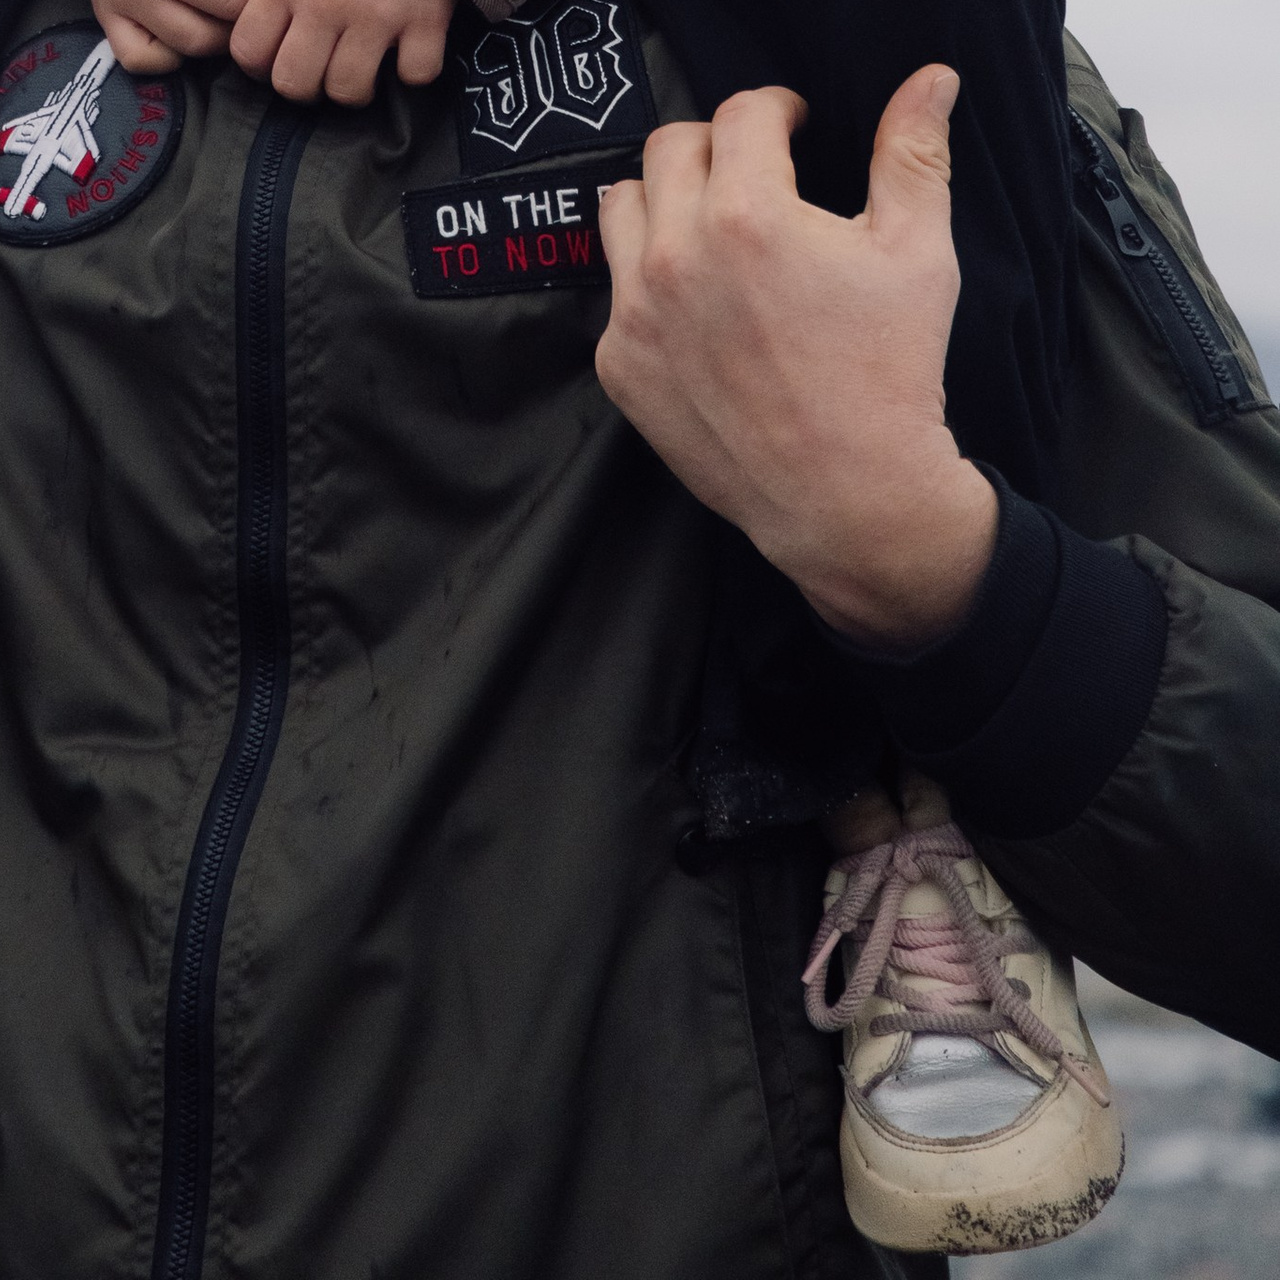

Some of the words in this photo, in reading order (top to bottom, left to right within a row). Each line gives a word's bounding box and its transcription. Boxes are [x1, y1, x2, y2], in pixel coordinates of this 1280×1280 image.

[66, 86, 167, 218] FASHION
[436, 200, 488, 238] ON
[502, 188, 582, 229] THE
[432, 243, 481, 279] TO
